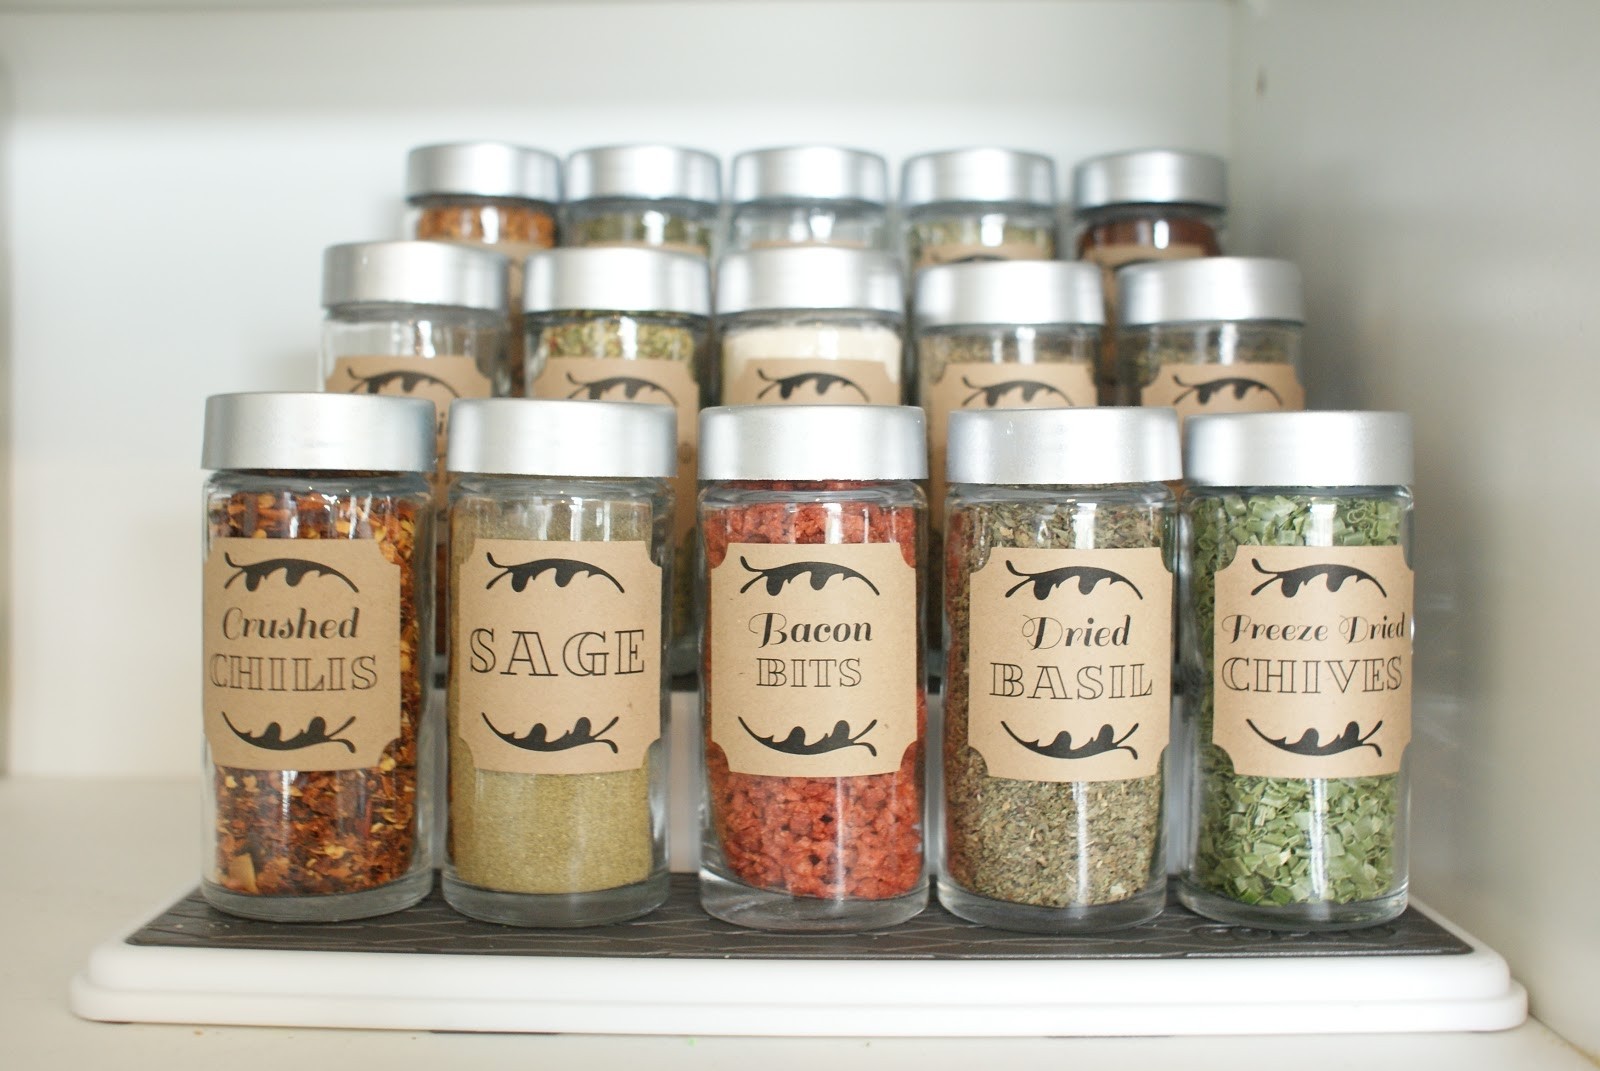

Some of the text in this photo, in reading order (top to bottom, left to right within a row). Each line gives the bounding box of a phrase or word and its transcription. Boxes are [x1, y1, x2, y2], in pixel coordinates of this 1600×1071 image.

[222, 606, 361, 641] Crushed
[747, 612, 874, 649] Bacon
[1021, 613, 1132, 651] Dried
[1221, 611, 1406, 645] Freeze Dried
[469, 627, 646, 677] SAGE
[208, 652, 379, 692] CHILIS
[755, 657, 863, 688] BITS
[988, 662, 1153, 700] BASIL
[1221, 655, 1402, 694] CHIVES
